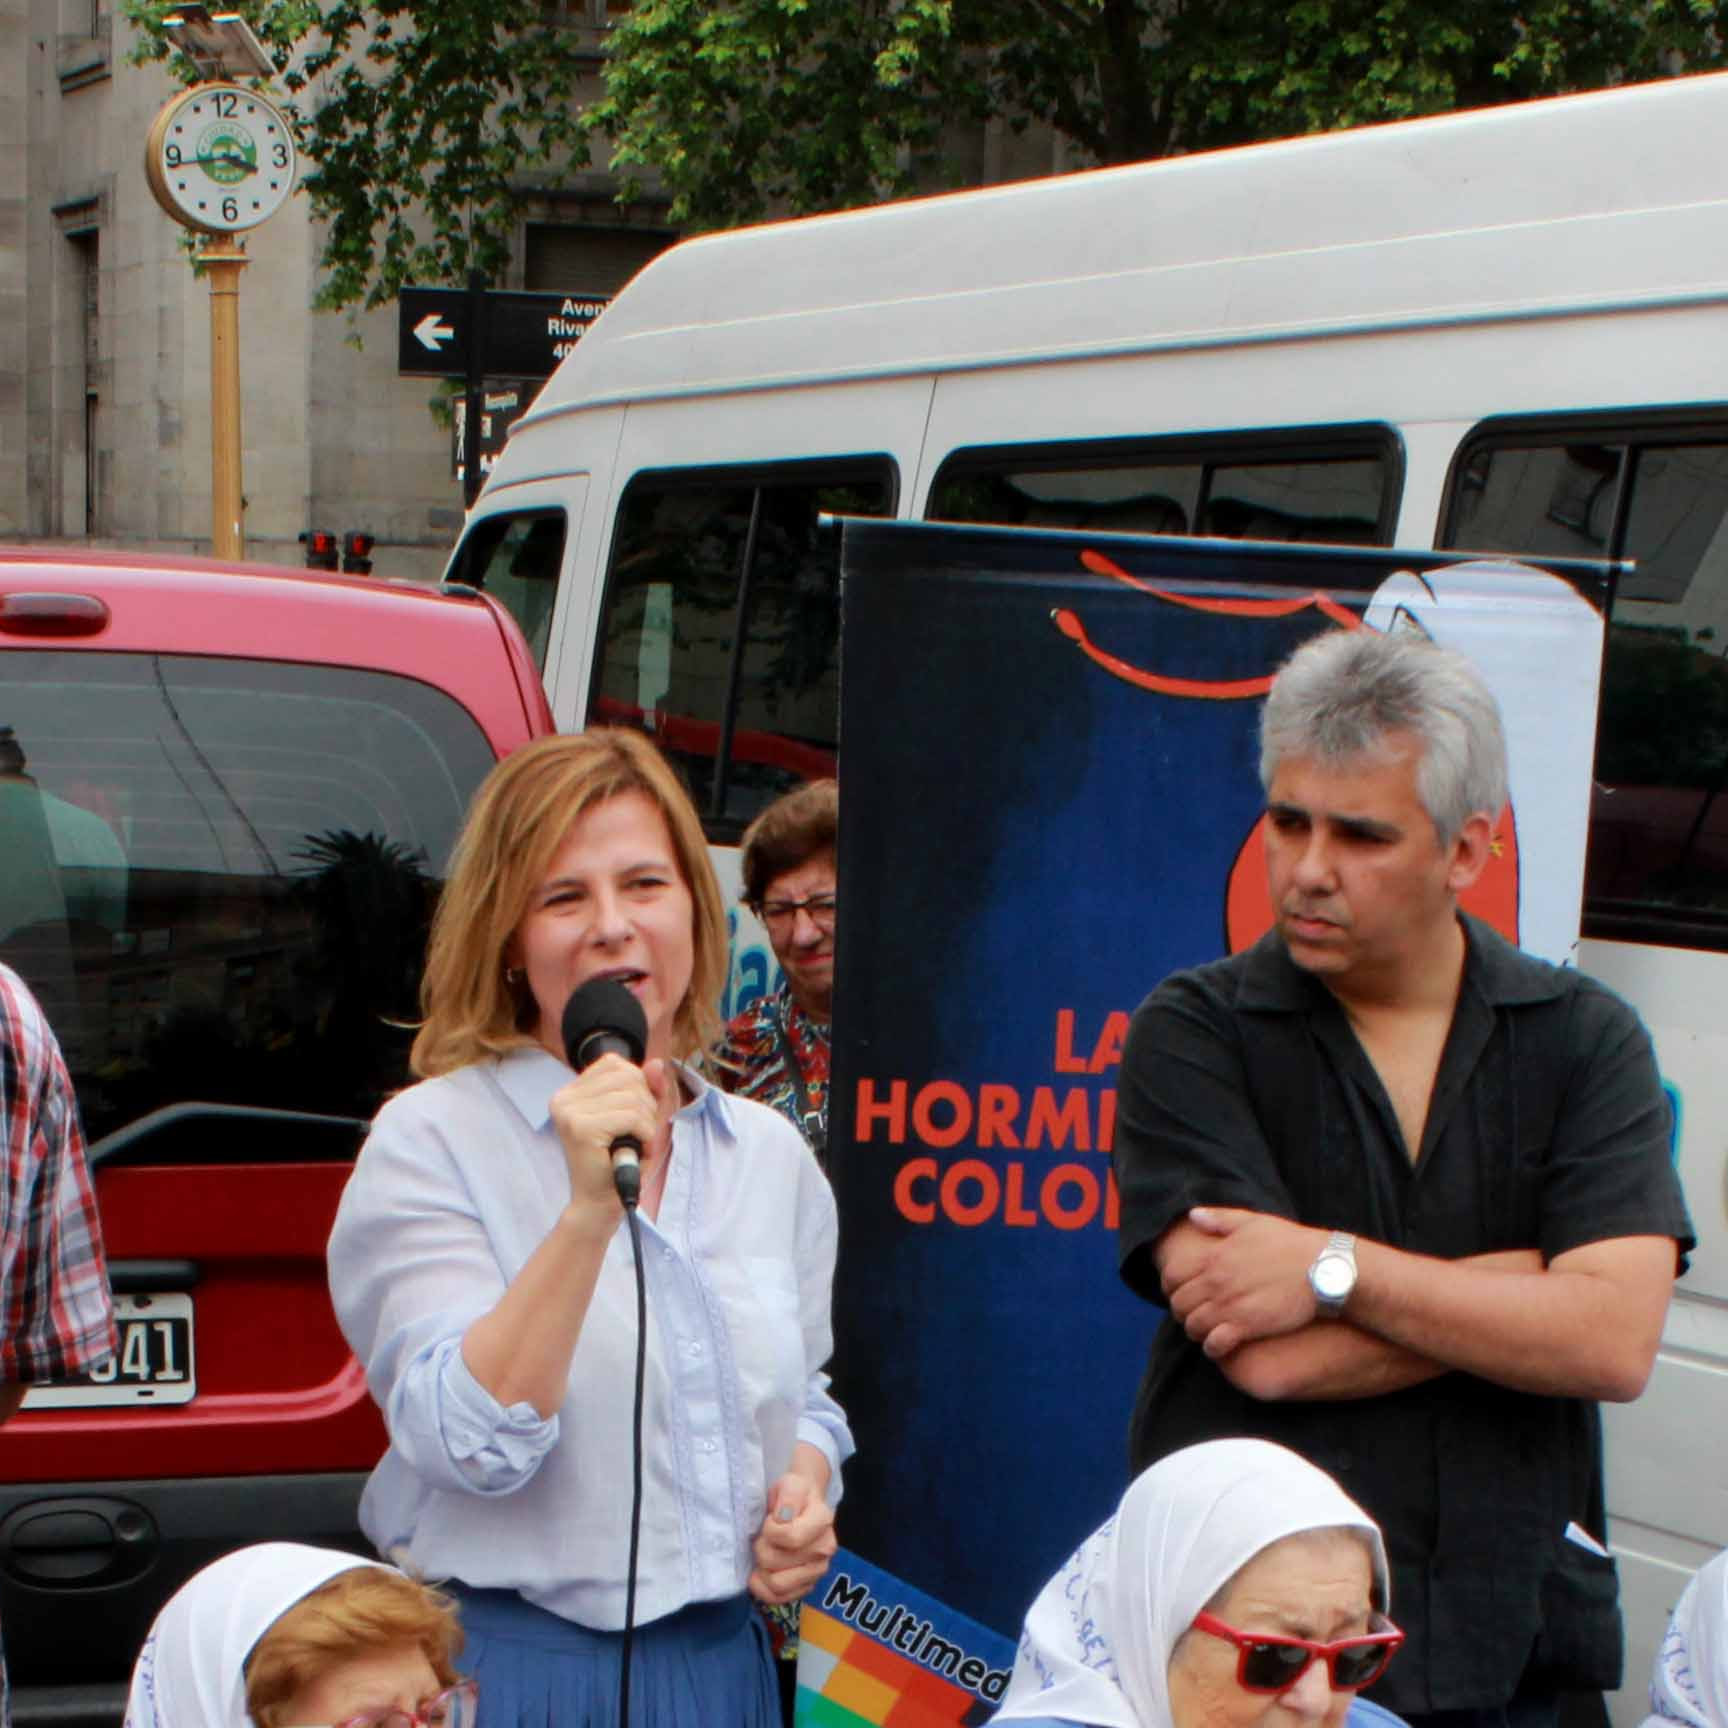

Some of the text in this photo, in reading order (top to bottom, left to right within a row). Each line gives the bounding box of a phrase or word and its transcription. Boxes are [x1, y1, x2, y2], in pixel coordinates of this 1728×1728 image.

[211, 92, 239, 118] 12
[166, 144, 288, 168] 9 3
[223, 197, 238, 222] 6
[560, 299, 611, 317] Aven
[547, 319, 589, 336] Riva
[553, 342, 573, 359] 40
[1053, 1009, 1130, 1074] LA
[854, 1079, 1117, 1152] HORMI
[823, 1575, 1015, 1704] Multimed
